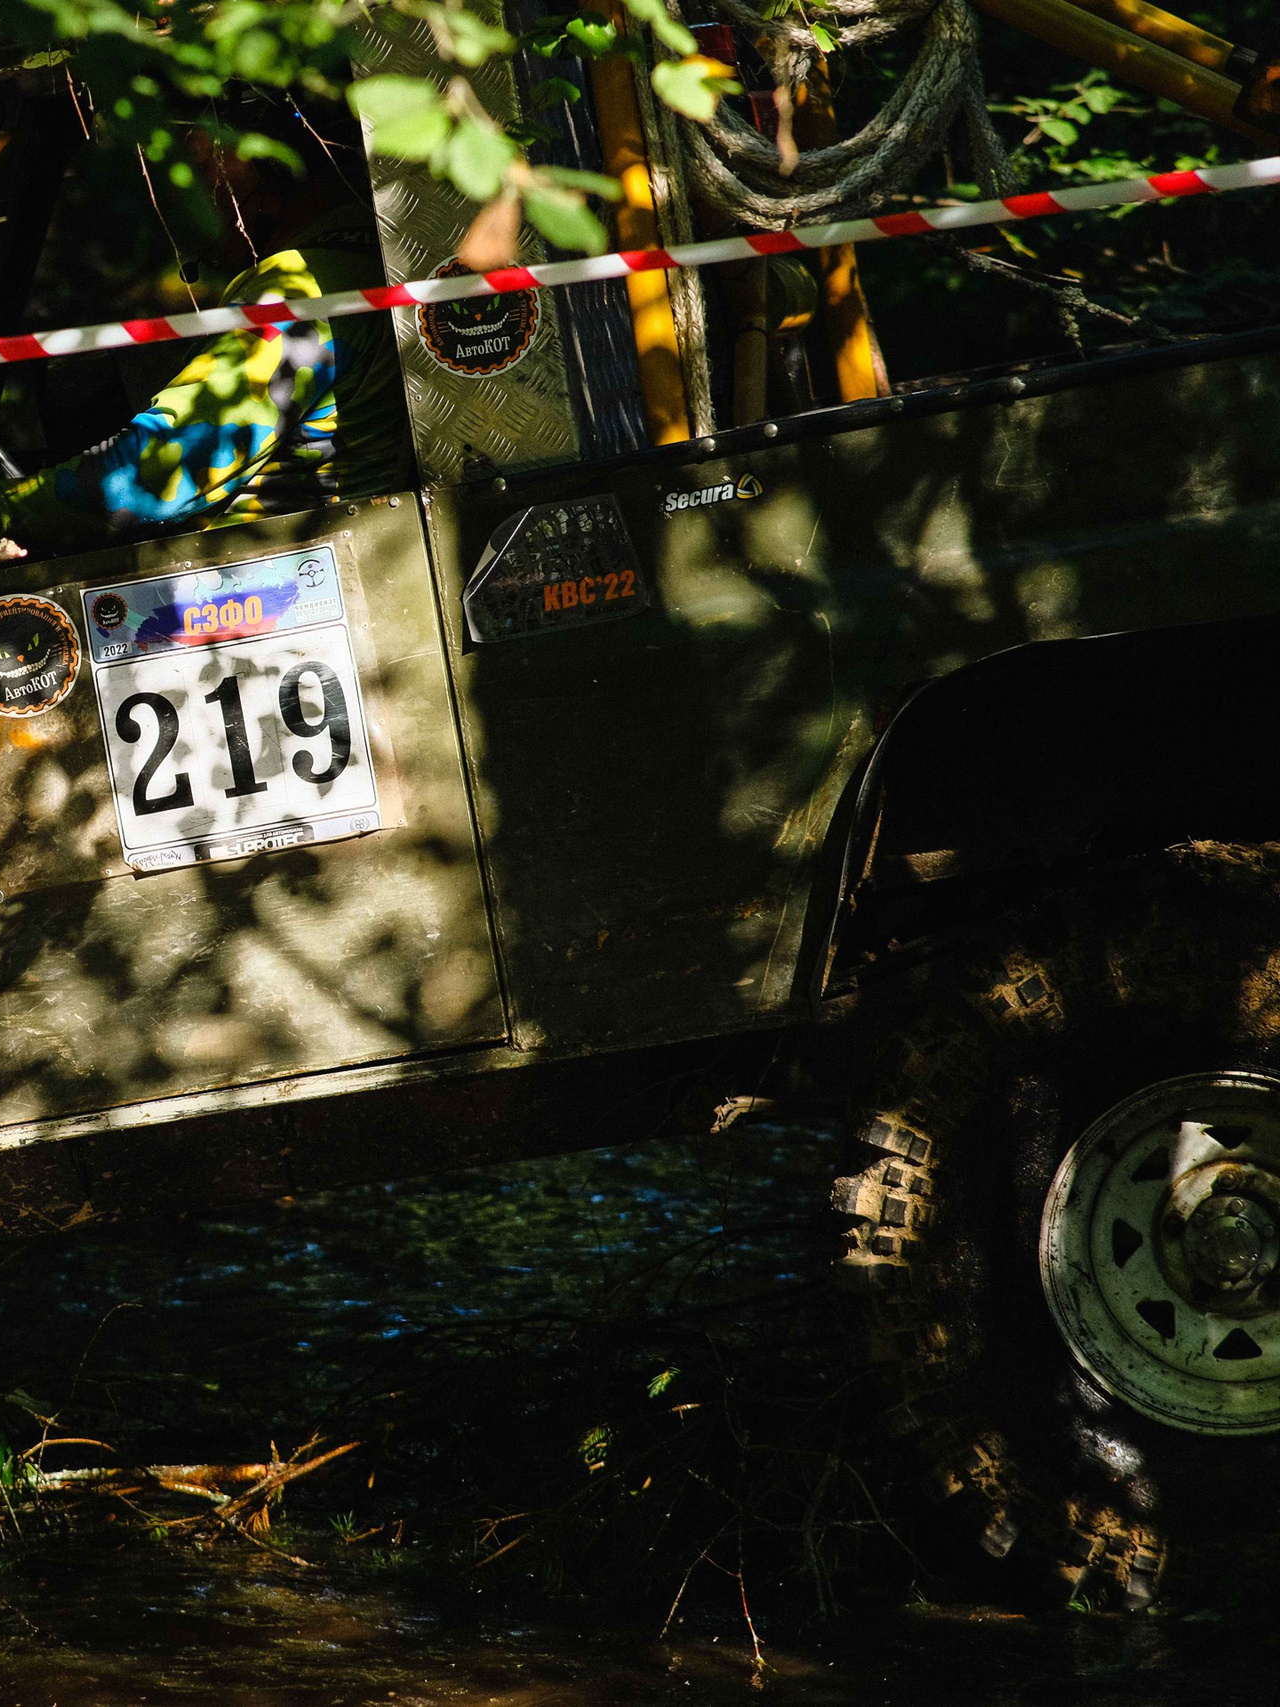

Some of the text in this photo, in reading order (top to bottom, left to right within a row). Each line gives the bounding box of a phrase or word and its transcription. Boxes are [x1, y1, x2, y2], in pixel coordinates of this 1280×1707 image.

[665, 484, 734, 512] Secura
[183, 595, 263, 635] СЗФО
[103, 643, 128, 657] 2022
[115, 660, 352, 816] 219
